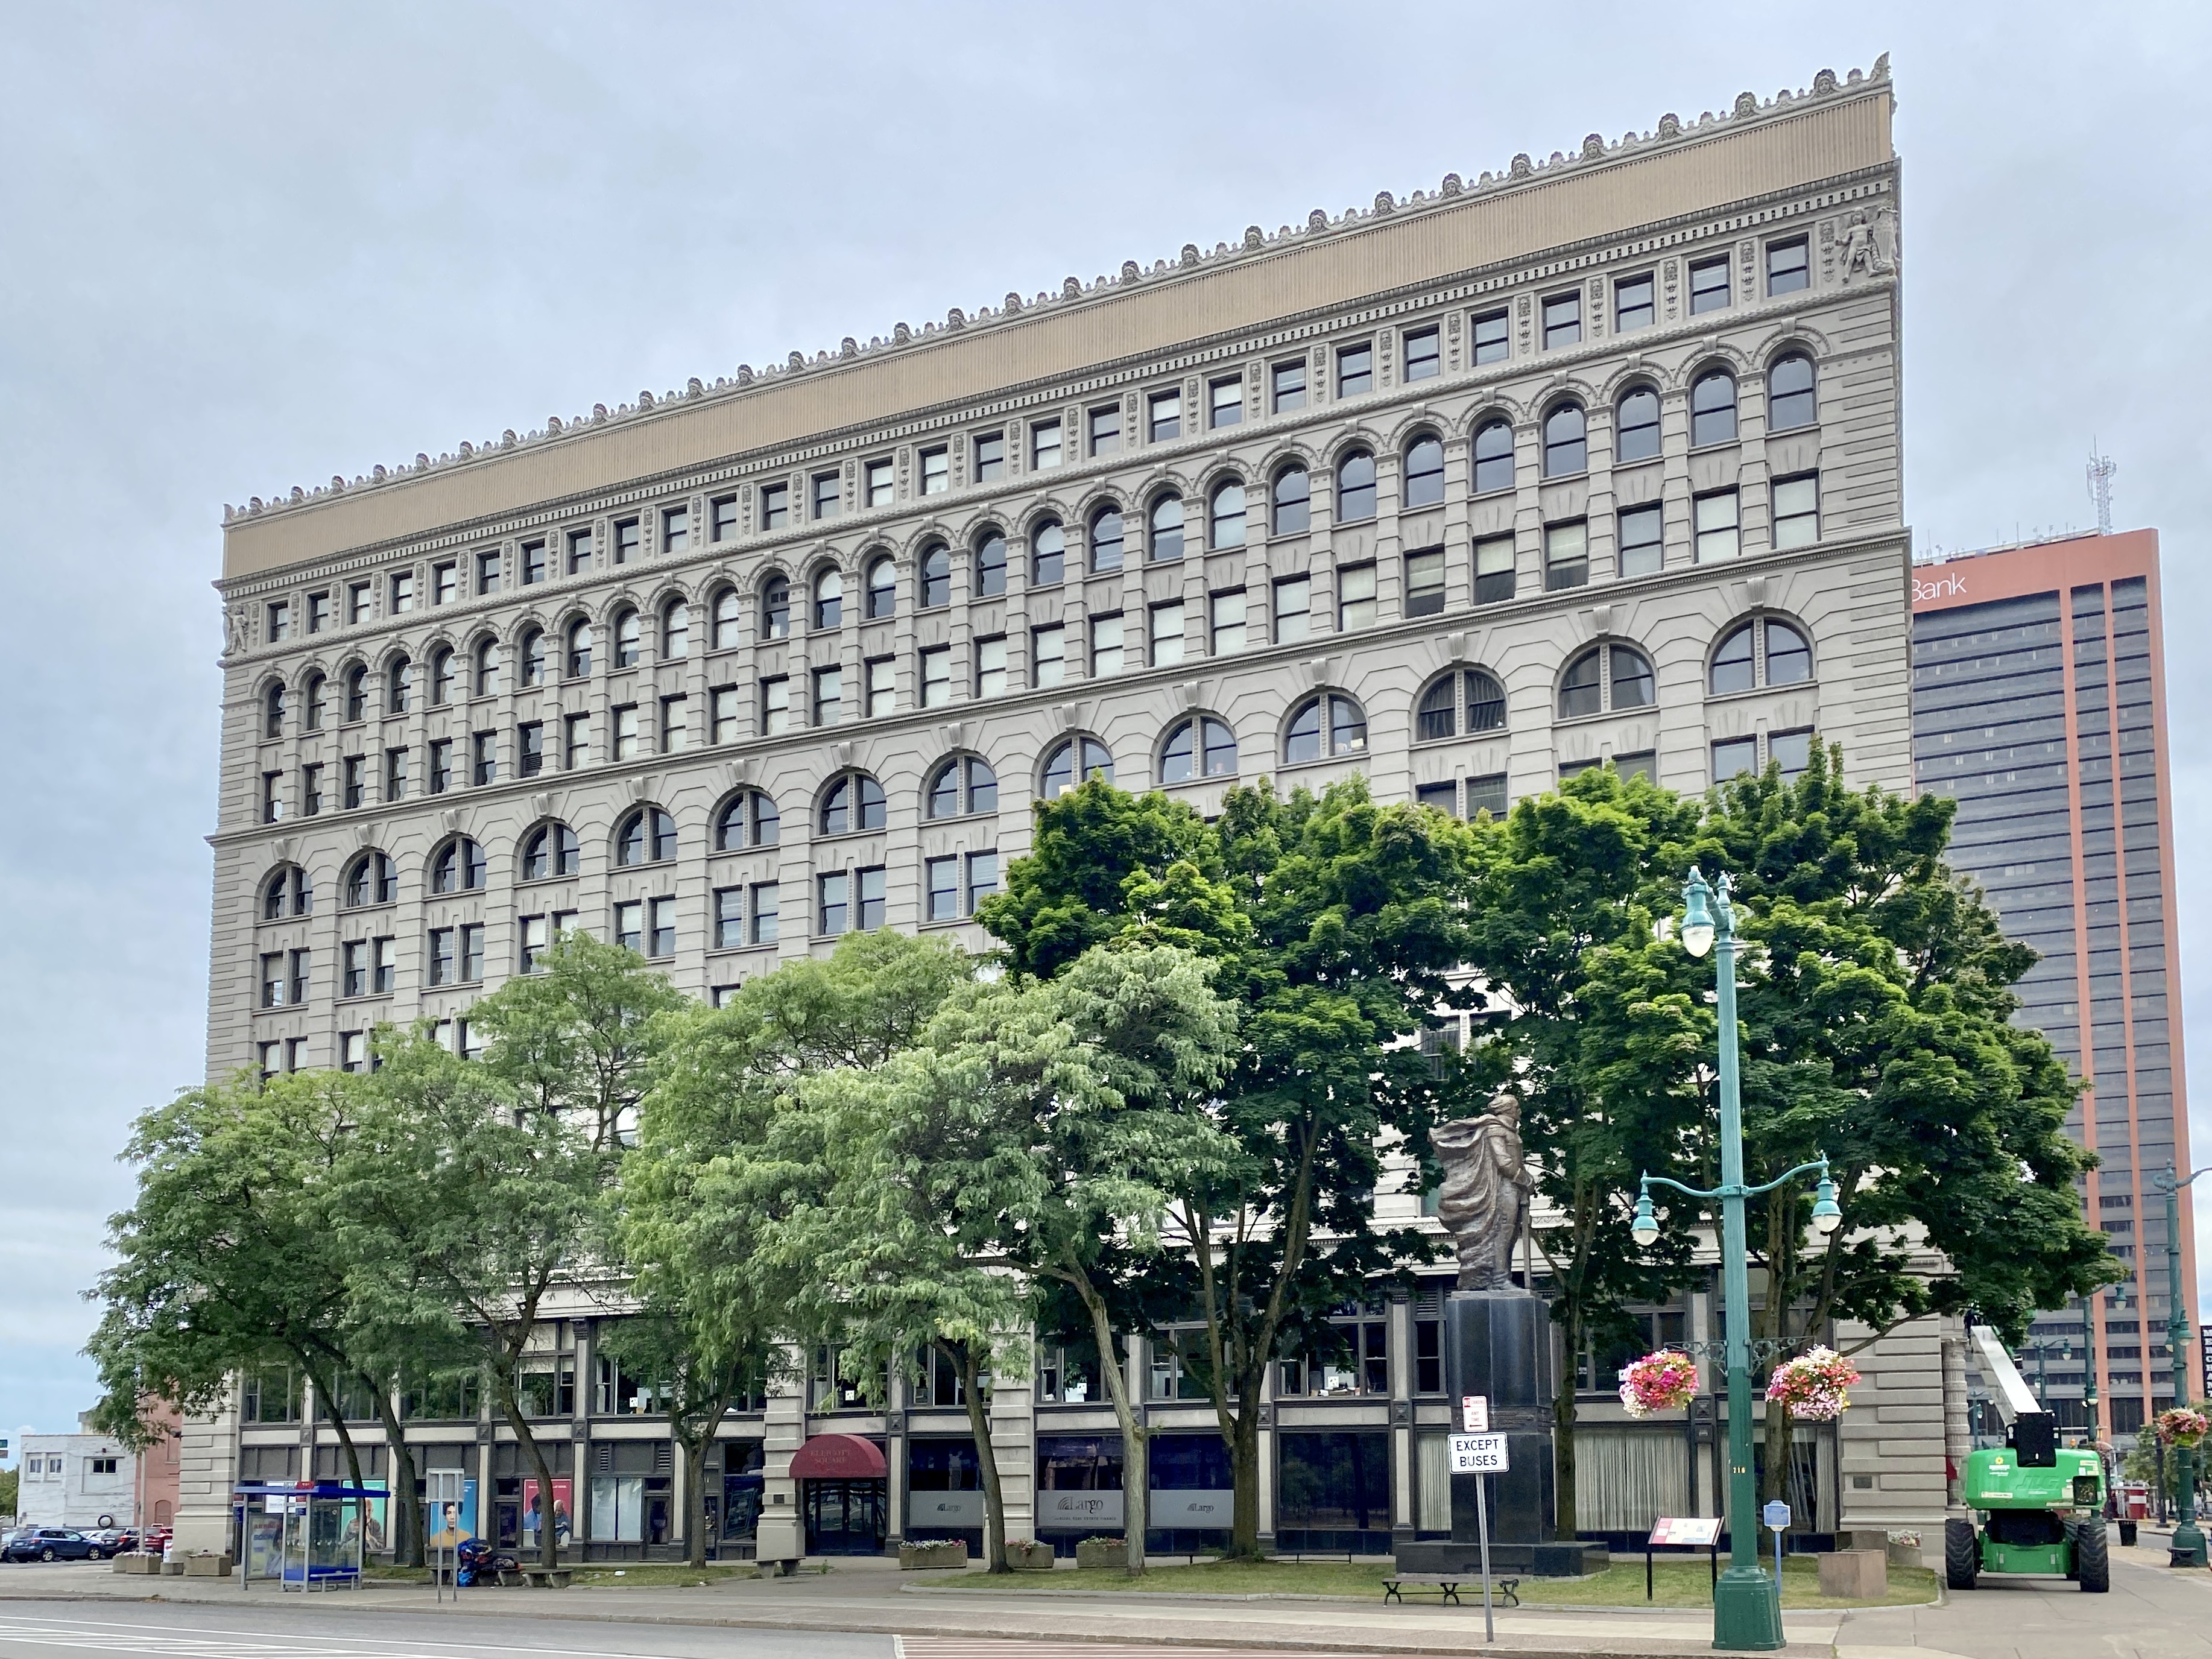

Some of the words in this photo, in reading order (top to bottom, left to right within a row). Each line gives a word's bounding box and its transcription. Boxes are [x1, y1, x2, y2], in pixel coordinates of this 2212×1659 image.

[1456, 1439, 1499, 1451] EXCEPT
[1460, 1455, 1497, 1467] BUSES
[2015, 1476, 2060, 1490] JLG
[943, 1503, 961, 1514] Largo
[1069, 1497, 1104, 1514] Largo
[1194, 1503, 1214, 1514] Largo
